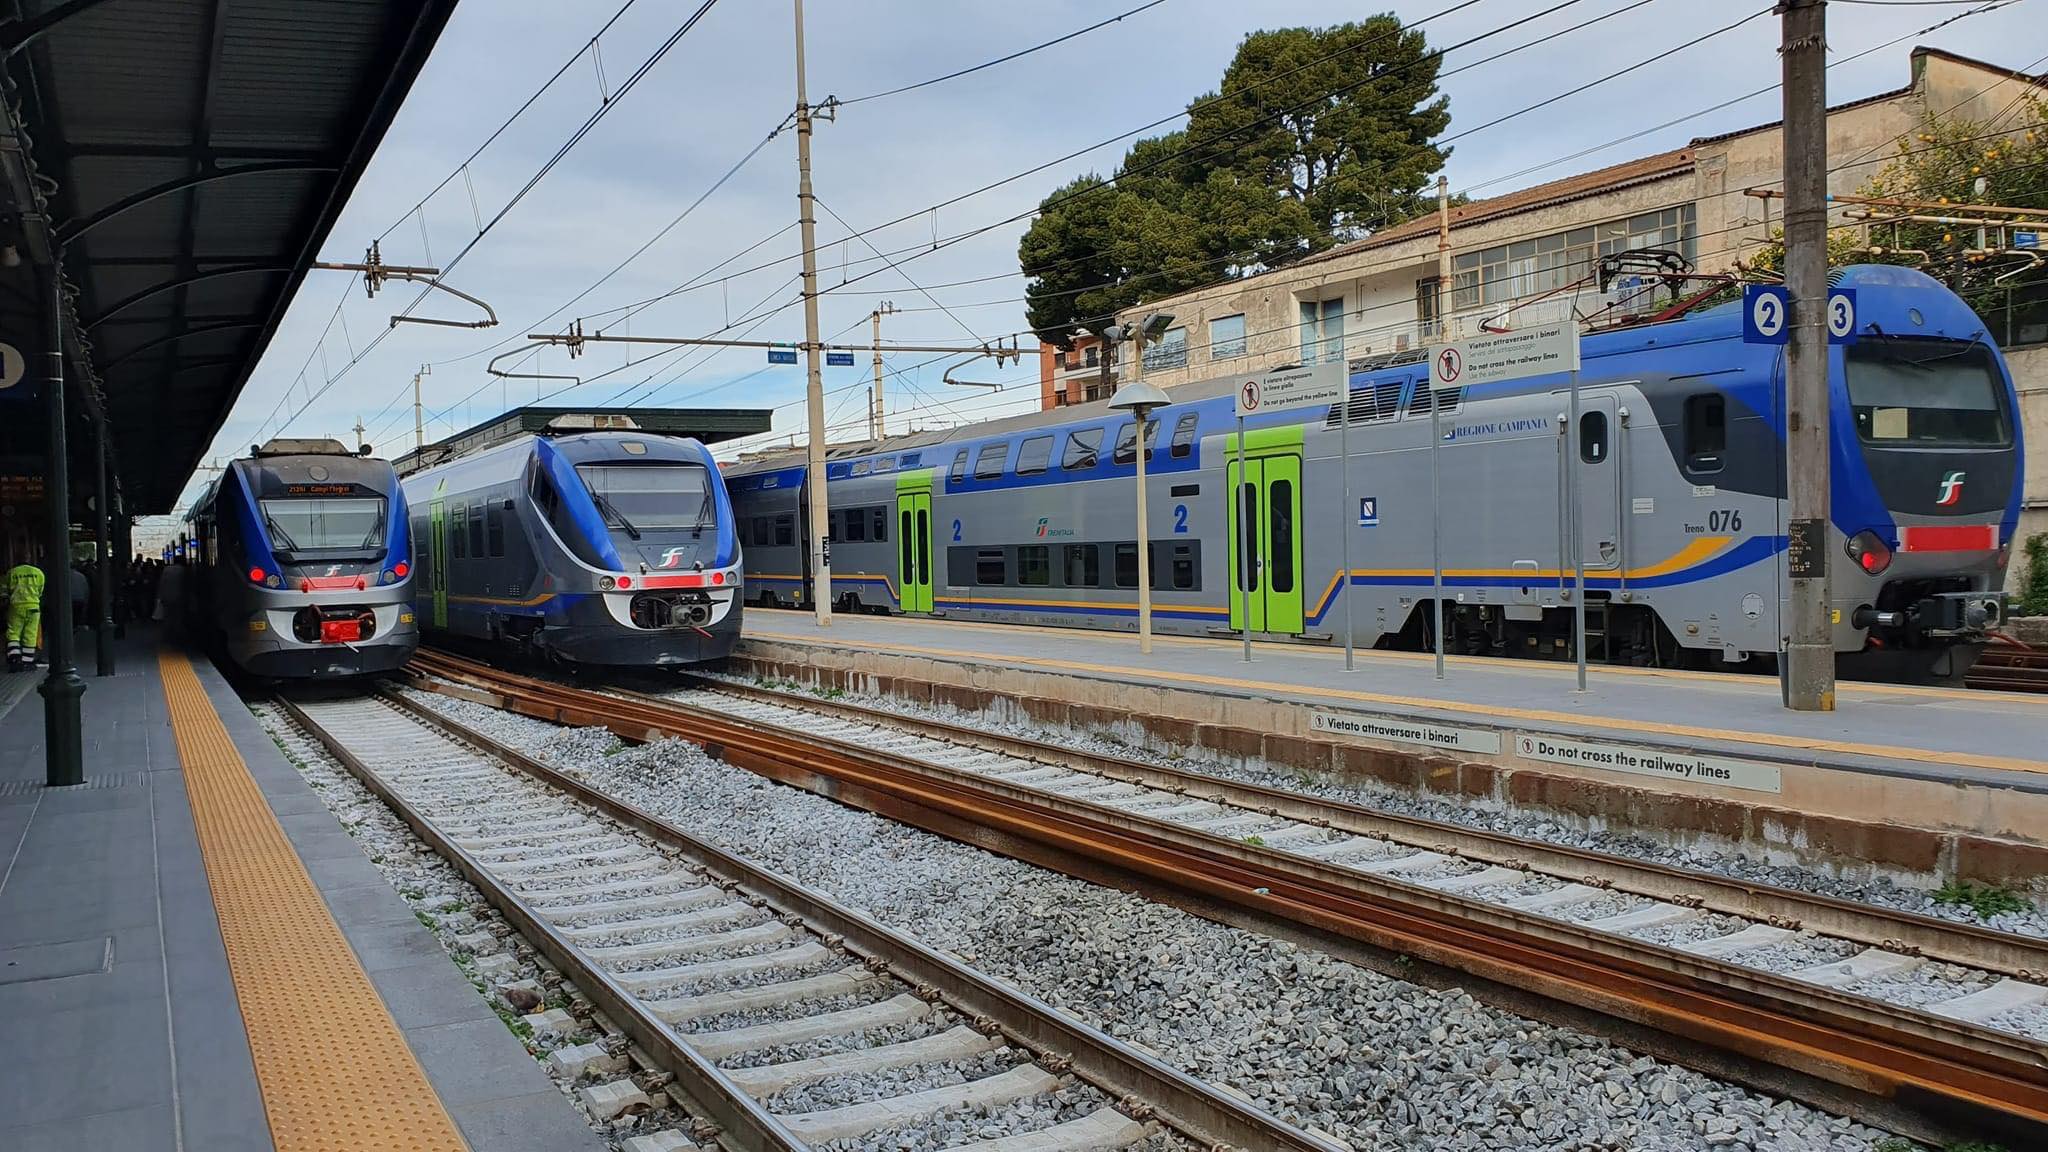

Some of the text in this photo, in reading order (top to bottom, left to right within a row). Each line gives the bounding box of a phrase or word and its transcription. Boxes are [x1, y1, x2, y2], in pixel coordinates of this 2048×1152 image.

[1761, 301, 1776, 328] 2
[1834, 302, 1847, 329] 3
[1468, 342, 1491, 350] Vietato
[1493, 334, 1534, 346] attraversare
[1540, 328, 1560, 338] binari
[1489, 361, 1505, 369] cross
[1517, 355, 1542, 364] railway
[1543, 353, 1558, 361] lines
[1286, 395, 1303, 404] beyond
[1313, 392, 1328, 400] yellow
[1457, 419, 1548, 437] REGIONE CAMPANIA
[952, 519, 961, 541] 2
[1174, 505, 1187, 533] 2
[1684, 510, 1742, 533] Treno 076
[1327, 718, 1458, 744] Vietato attraversare i binari
[1539, 742, 1731, 780] Do not cross the railway lines
